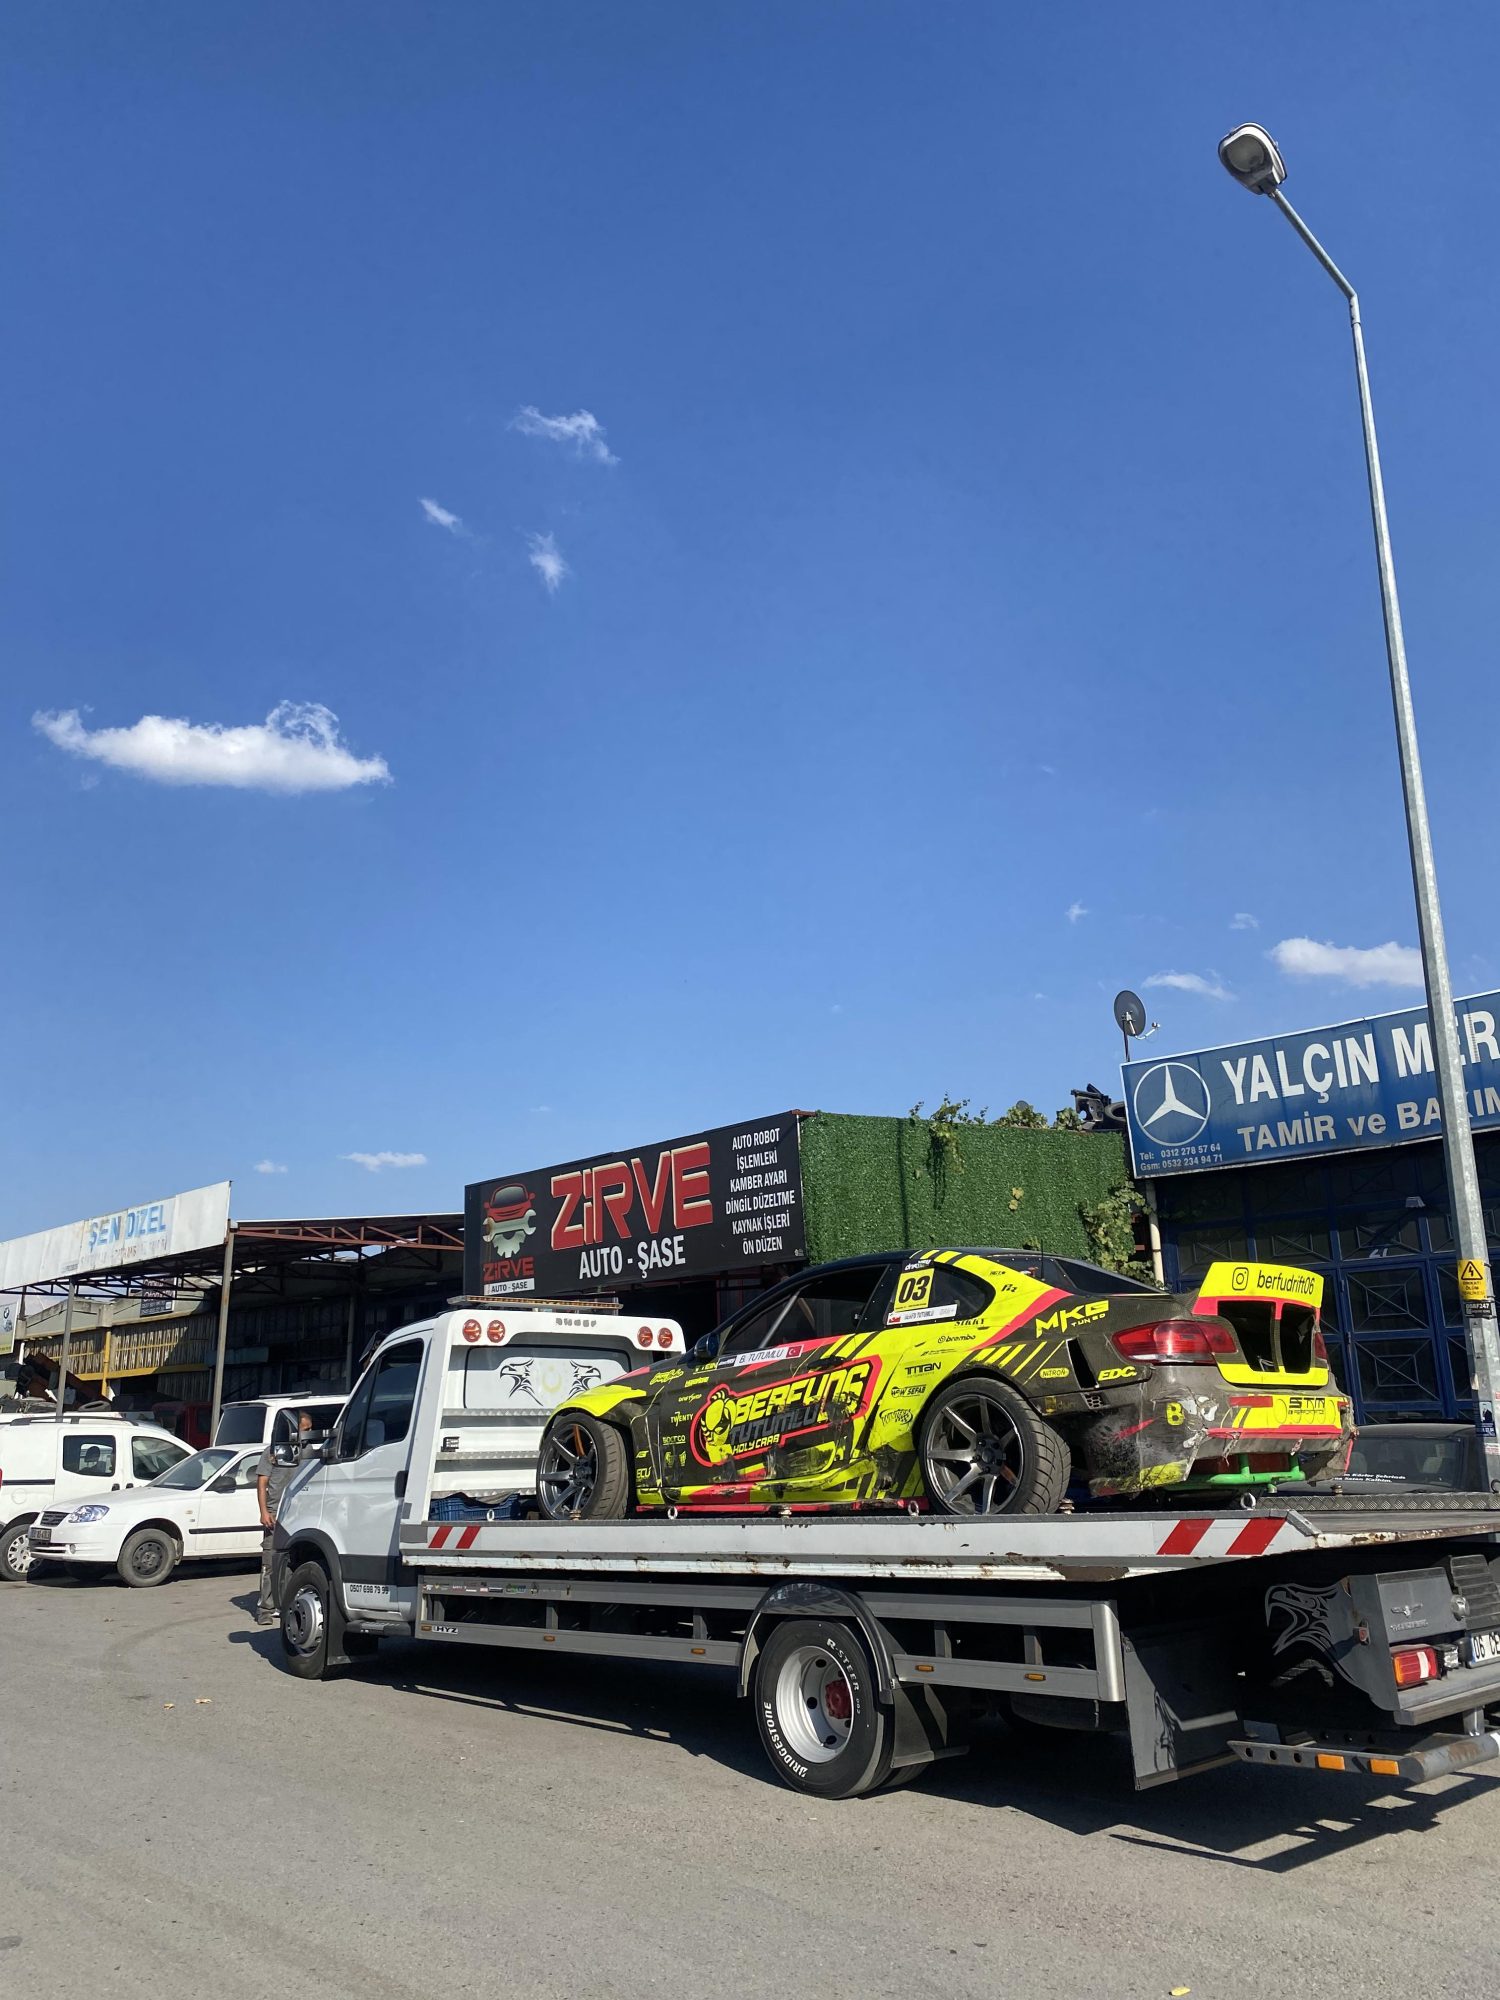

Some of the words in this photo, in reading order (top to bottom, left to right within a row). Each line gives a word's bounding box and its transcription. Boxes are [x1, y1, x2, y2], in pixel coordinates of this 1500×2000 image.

[1221, 1033, 1381, 1104] YALÇIN
[731, 1132, 752, 1151] AUTO
[753, 1127, 780, 1149] ROBOT
[1236, 1110, 1336, 1152] TAMİR
[1347, 1113, 1387, 1137] ve
[736, 1149, 778, 1172] İŞLEMLERİ
[1139, 1151, 1155, 1161] Tel:
[1161, 1148, 1179, 1158] 0312
[1181, 1146, 1196, 1156] 278
[1198, 1144, 1208, 1154] 57
[1162, 1159, 1182, 1169] 0532
[730, 1175, 764, 1193] KAMBER
[764, 1169, 788, 1188] AYARI
[725, 1196, 752, 1215] DİNGİL
[753, 1189, 796, 1211] DÜZELTME
[731, 1218, 763, 1235] KAYNAK
[763, 1208, 790, 1232] İŞLERİ
[579, 1245, 623, 1280] AUTO
[637, 1234, 686, 1279] ŞASE
[742, 1237, 756, 1255] ÖN
[756, 1235, 783, 1253] DÜZEN
[491, 1284, 507, 1293] AUTO
[898, 1275, 931, 1304] 03
[1257, 1270, 1316, 1296] berfudrift06
[748, 1349, 783, 1361] TUTUMLU
[826, 1637, 860, 1691] R-STEER
[763, 1701, 809, 1779] BRIDGESTONE
